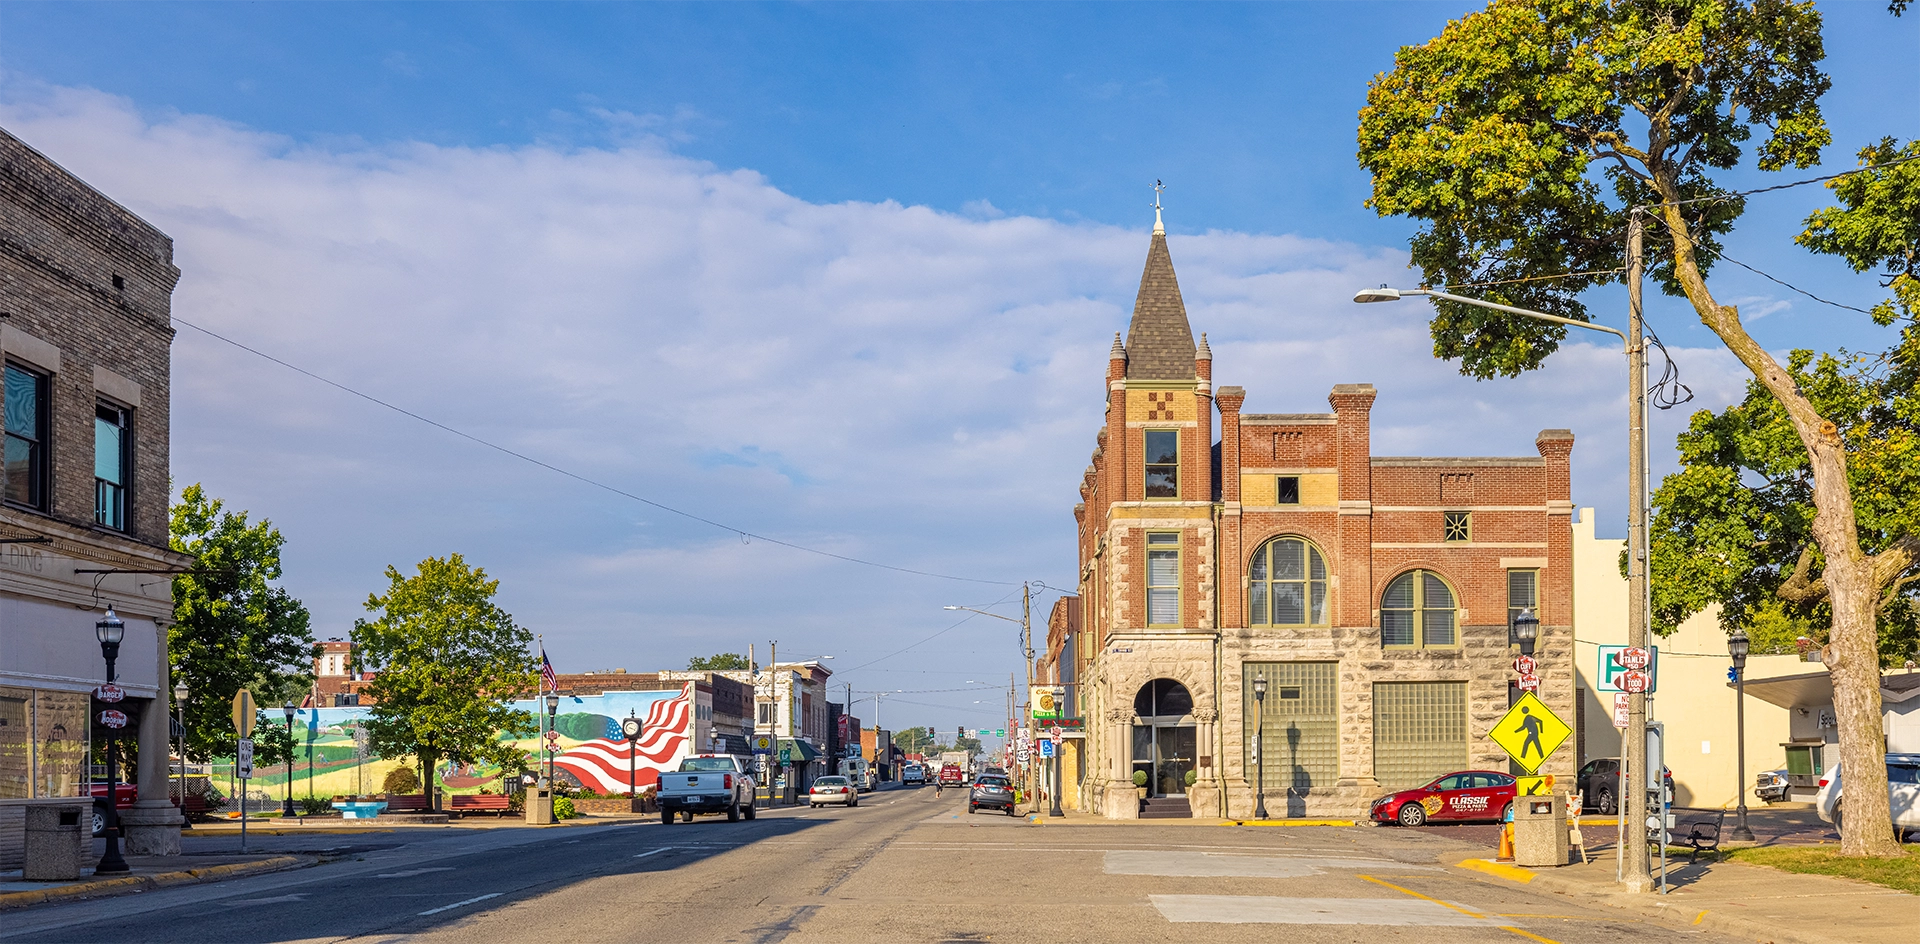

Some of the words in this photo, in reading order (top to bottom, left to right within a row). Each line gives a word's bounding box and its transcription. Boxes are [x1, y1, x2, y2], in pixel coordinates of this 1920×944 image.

[1627, 679, 1642, 687] TODD
[241, 742, 251, 751] ONE
[241, 754, 252, 762] WAY
[1449, 796, 1490, 804] CLASSIC
